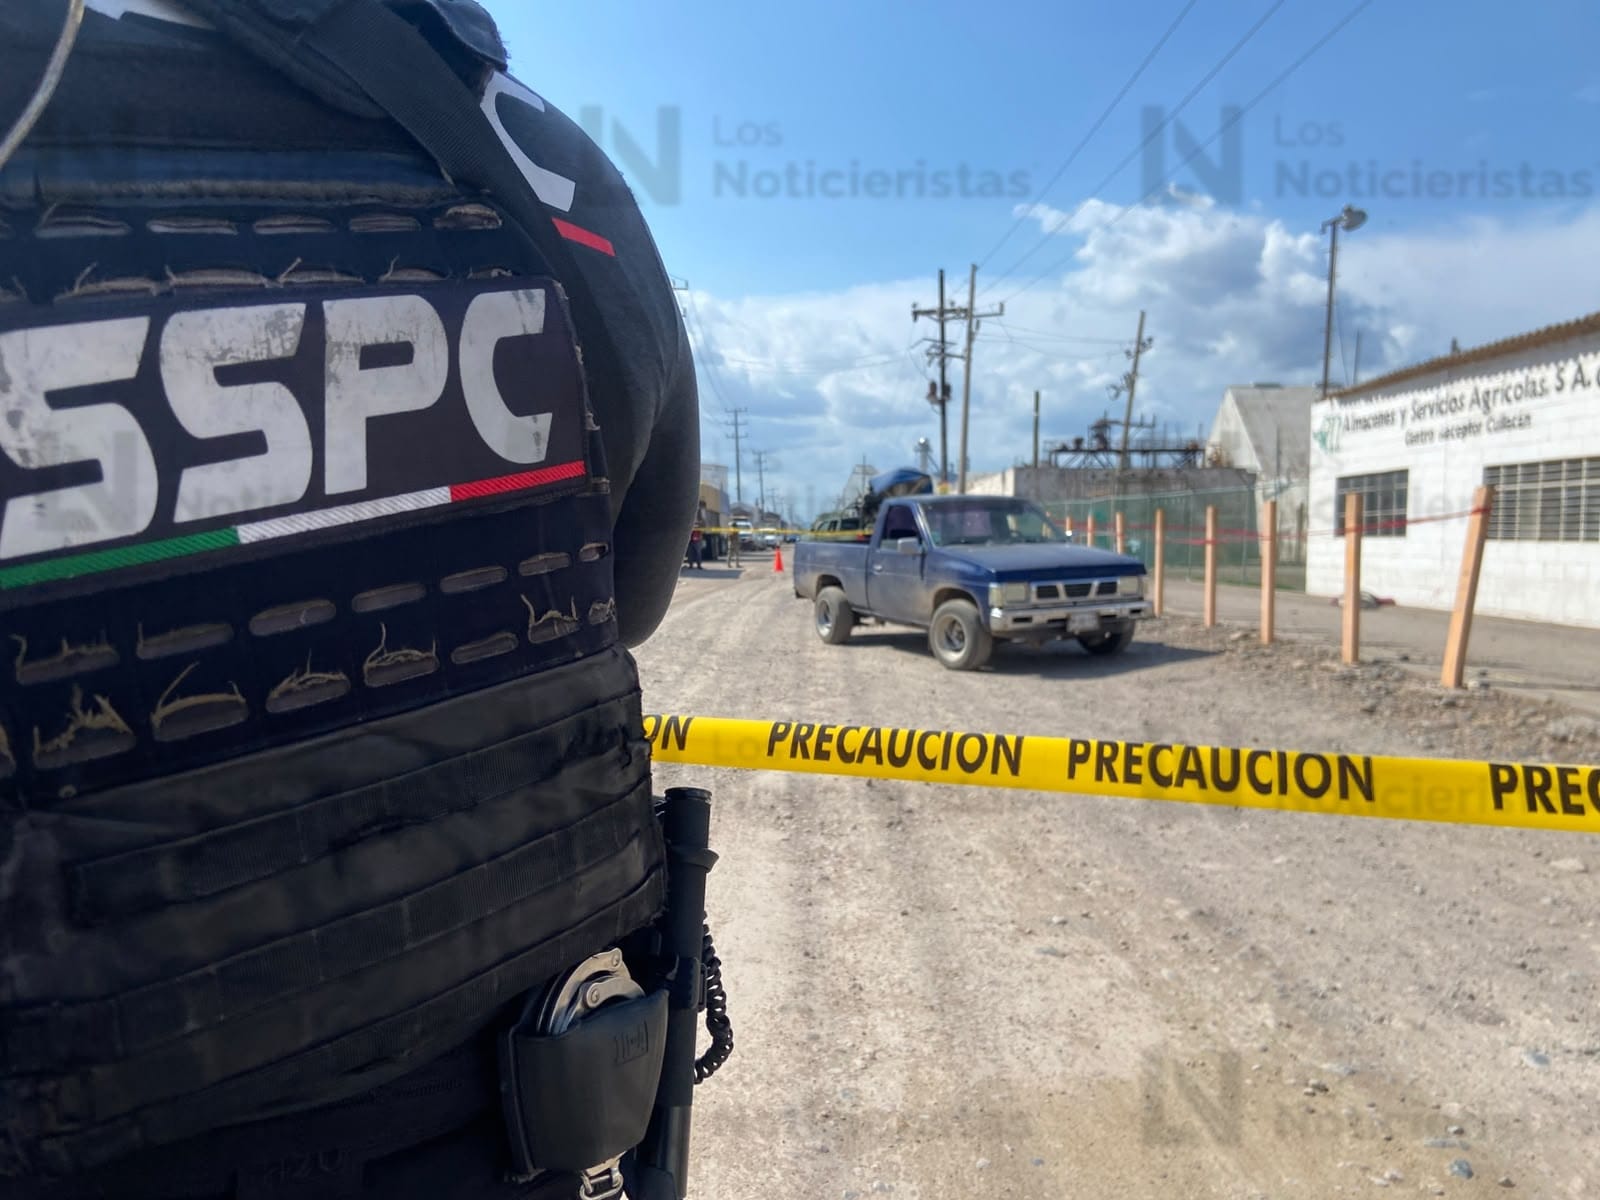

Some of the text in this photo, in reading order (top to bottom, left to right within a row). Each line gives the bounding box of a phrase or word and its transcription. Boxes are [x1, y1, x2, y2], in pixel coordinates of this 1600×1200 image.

[0, 287, 554, 559] SSPC
[766, 719, 1025, 778] PRECAUCION
[1067, 738, 1376, 802] PRECAUCION
